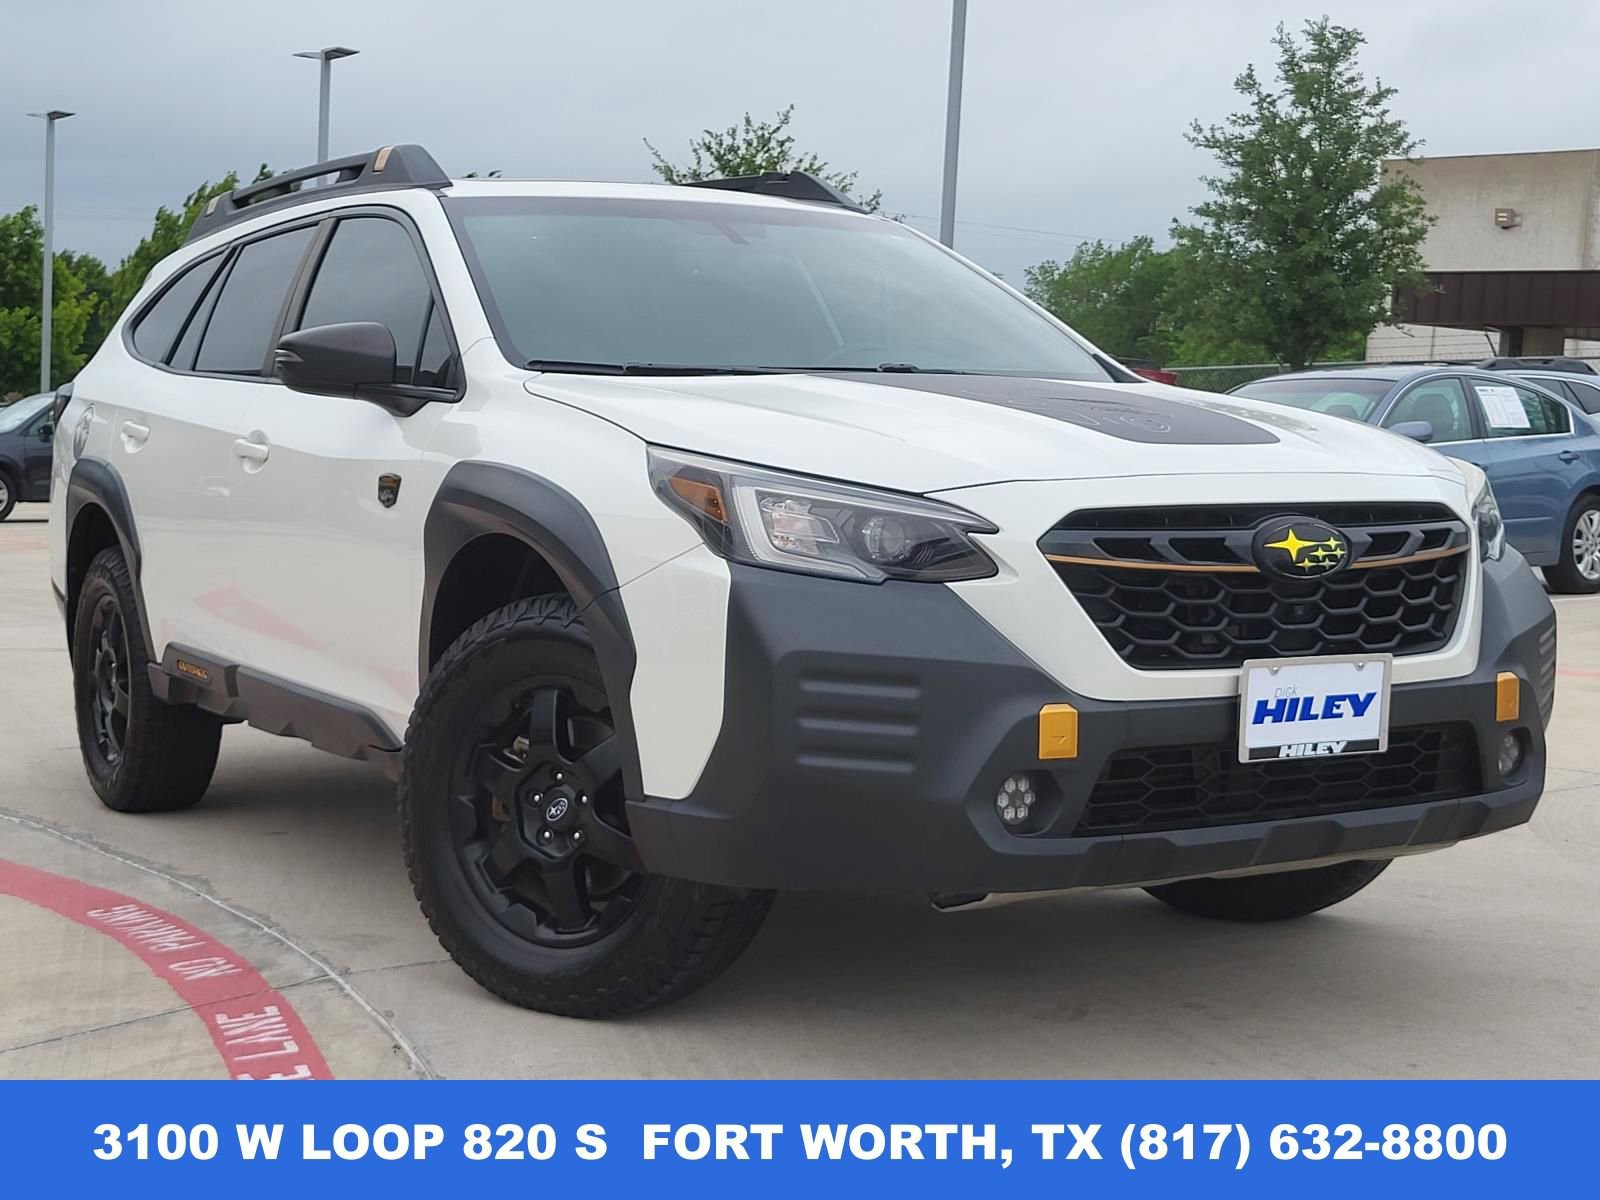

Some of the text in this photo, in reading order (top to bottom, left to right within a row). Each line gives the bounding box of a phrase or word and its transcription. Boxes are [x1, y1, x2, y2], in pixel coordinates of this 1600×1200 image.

[1251, 691, 1377, 725] HILEY
[1278, 740, 1347, 758] HILEY
[168, 956, 243, 981] NO
[215, 1005, 300, 1061] LANE
